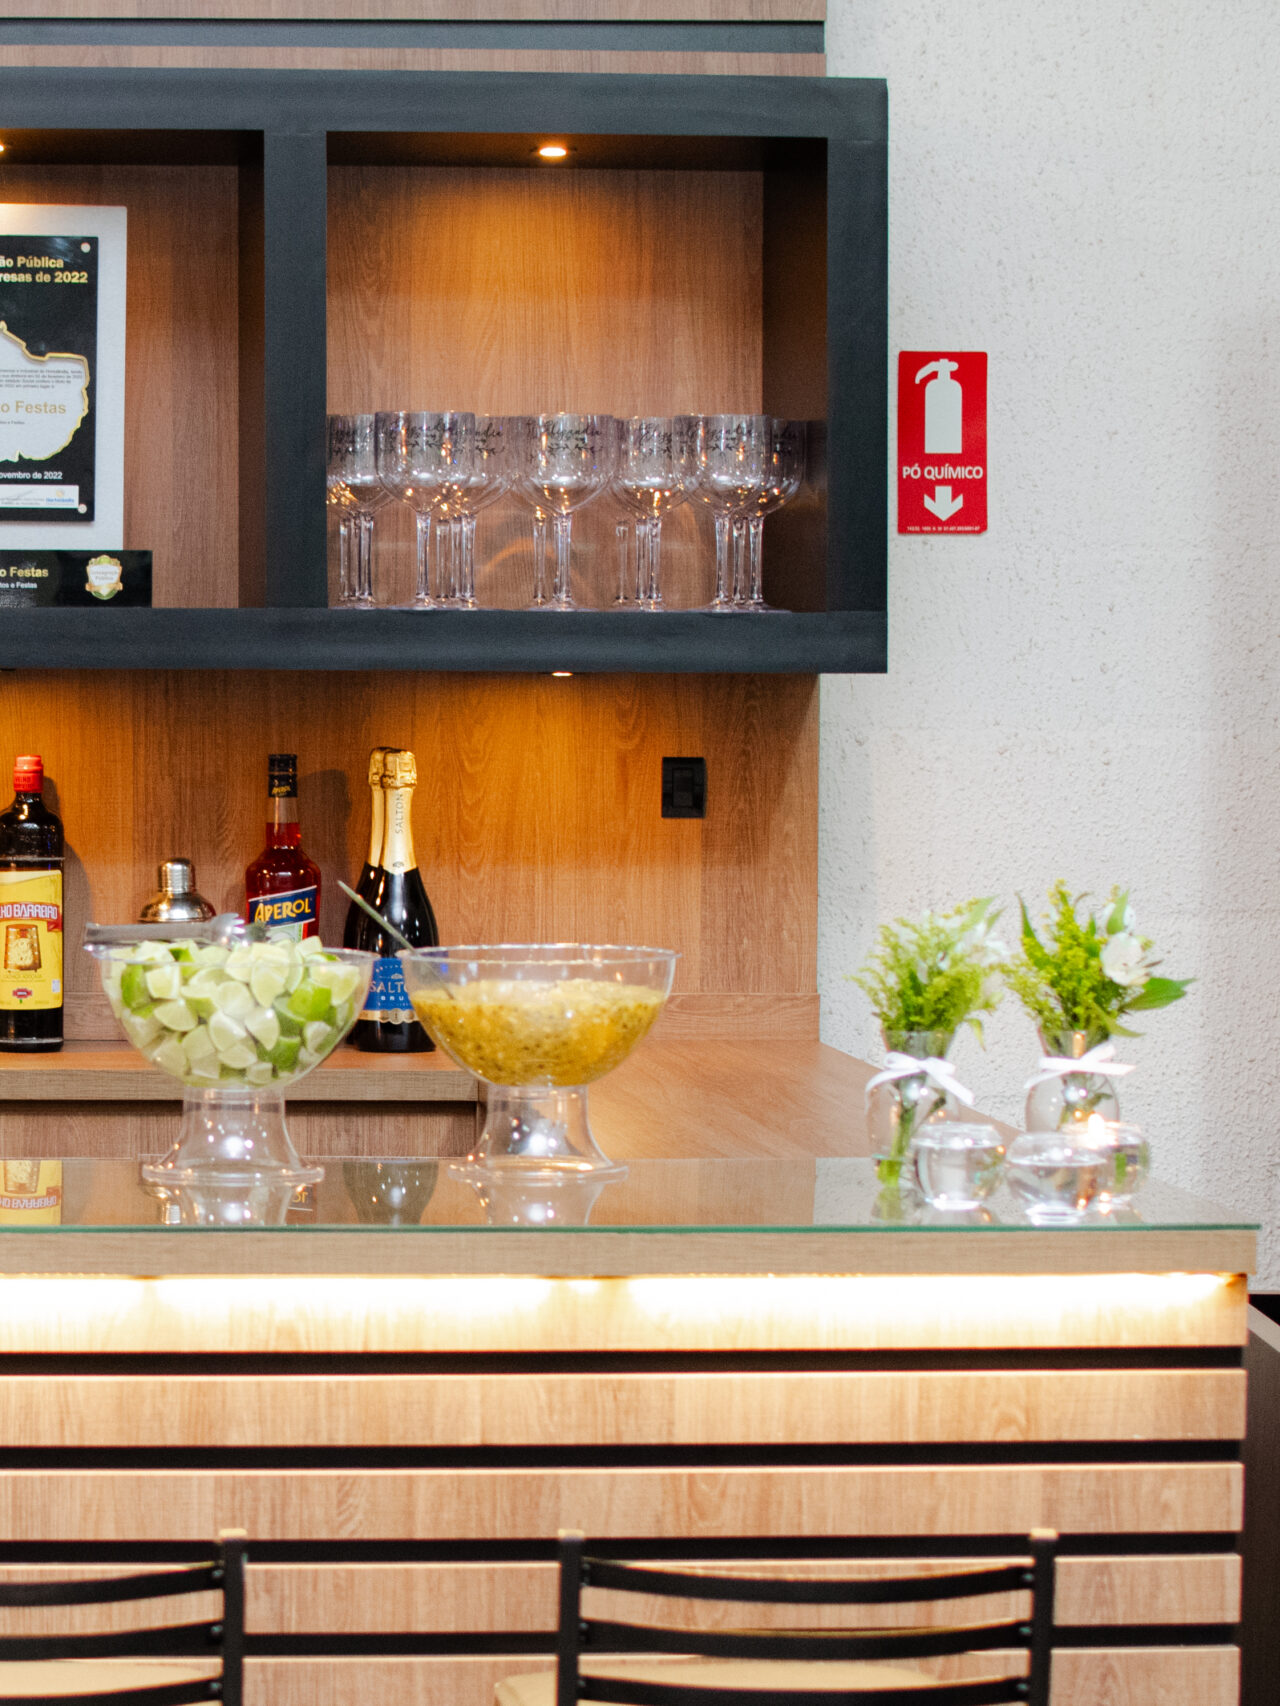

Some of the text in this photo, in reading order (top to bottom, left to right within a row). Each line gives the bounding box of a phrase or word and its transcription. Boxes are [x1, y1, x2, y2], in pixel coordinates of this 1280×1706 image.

[17, 255, 64, 268] Pública
[35, 271, 51, 282] de
[54, 271, 88, 283] 2022
[15, 400, 66, 414] Festas
[32, 471, 42, 479] de
[43, 471, 63, 480] 2022
[902, 463, 983, 480] PÓ QUÍMICO
[10, 566, 48, 578] Festas
[254, 898, 312, 923] APEROL
